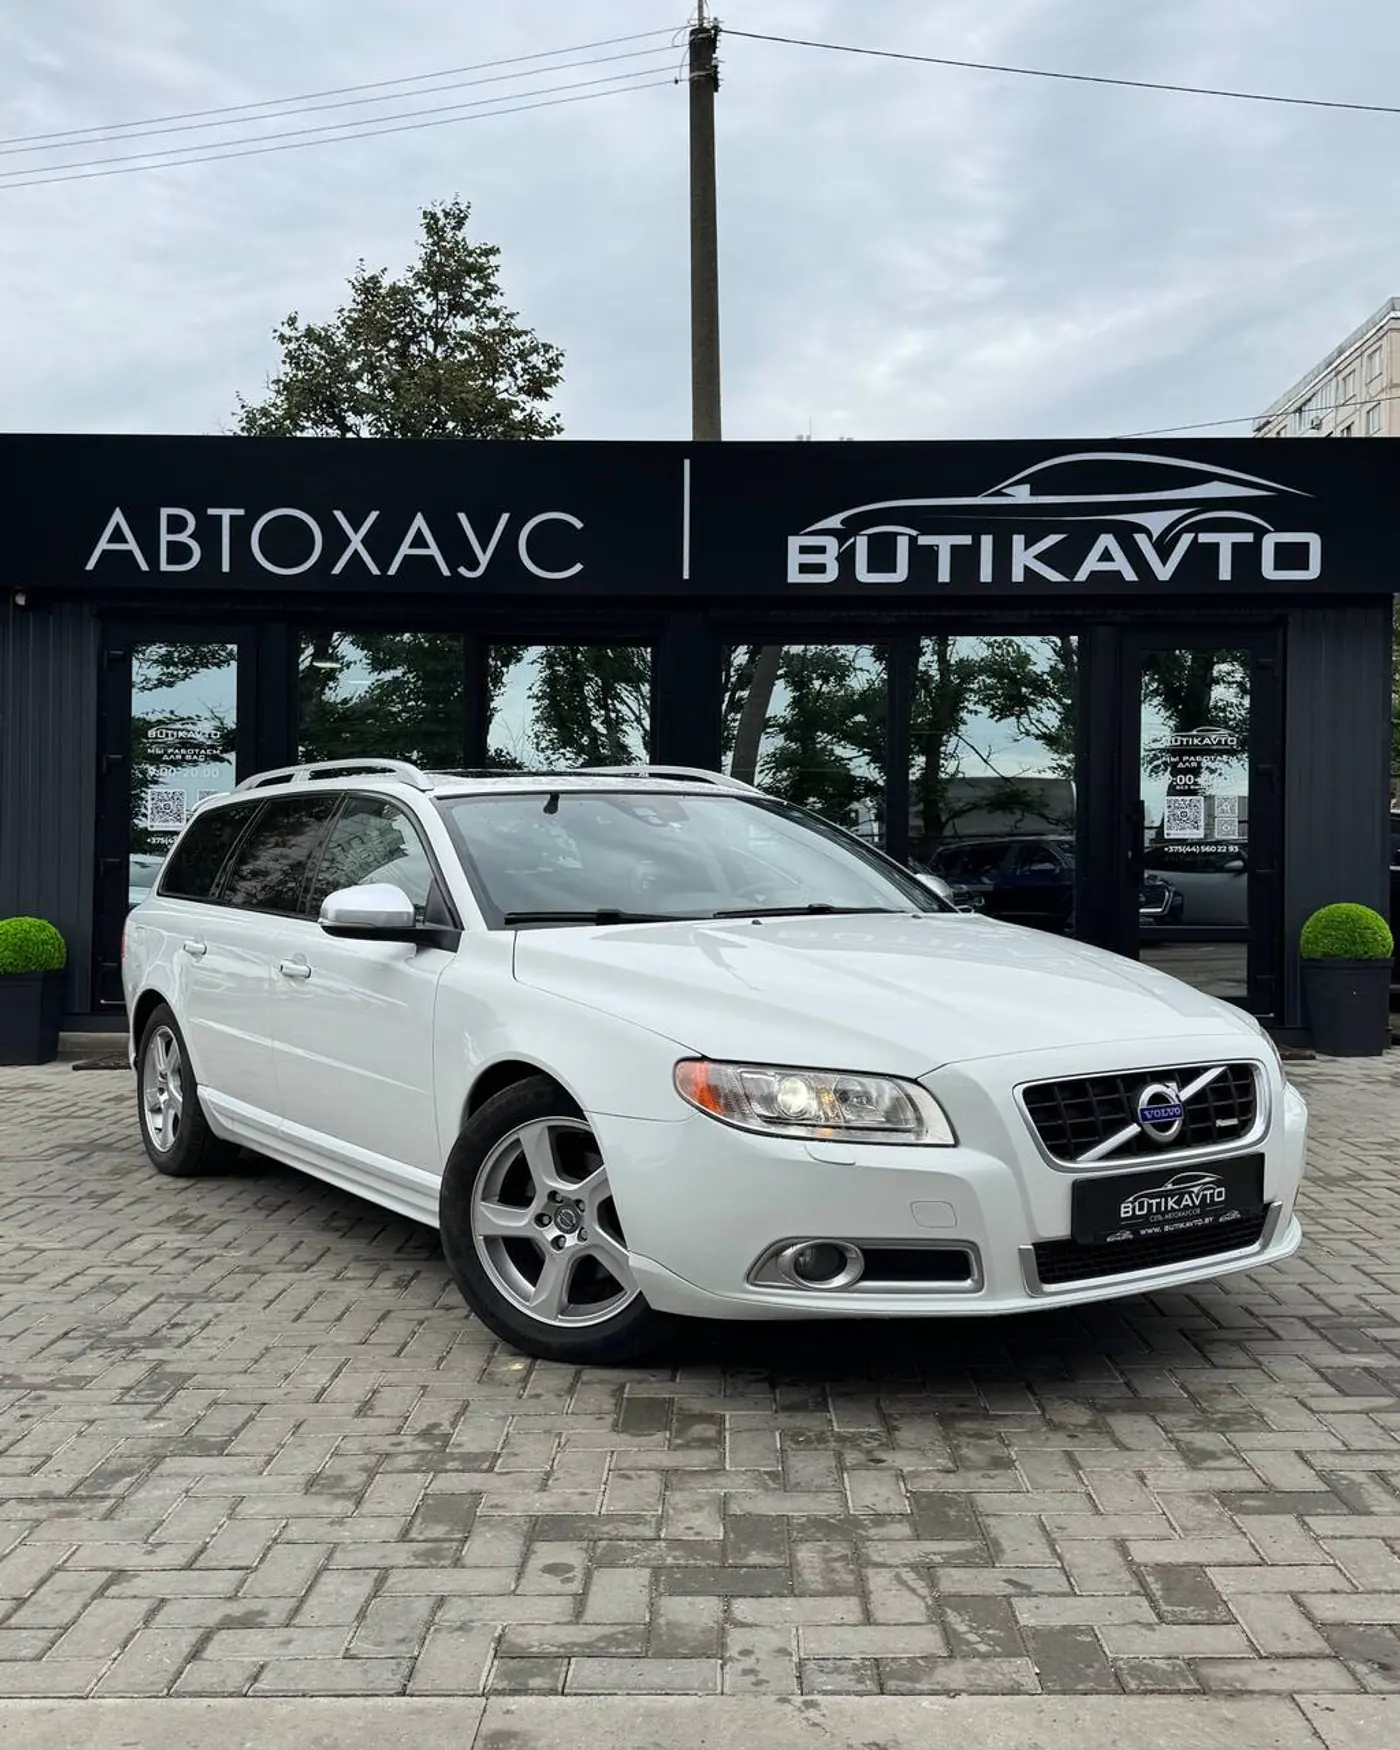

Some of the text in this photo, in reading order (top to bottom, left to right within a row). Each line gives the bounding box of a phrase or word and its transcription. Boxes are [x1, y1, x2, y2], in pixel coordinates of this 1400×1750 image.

[85, 506, 585, 579] АВТОХАУС
[787, 531, 1322, 583] BUTIKAVTO
[1143, 1107, 1181, 1119] VOLVO
[1120, 1187, 1226, 1218] BUTIKAVTO
